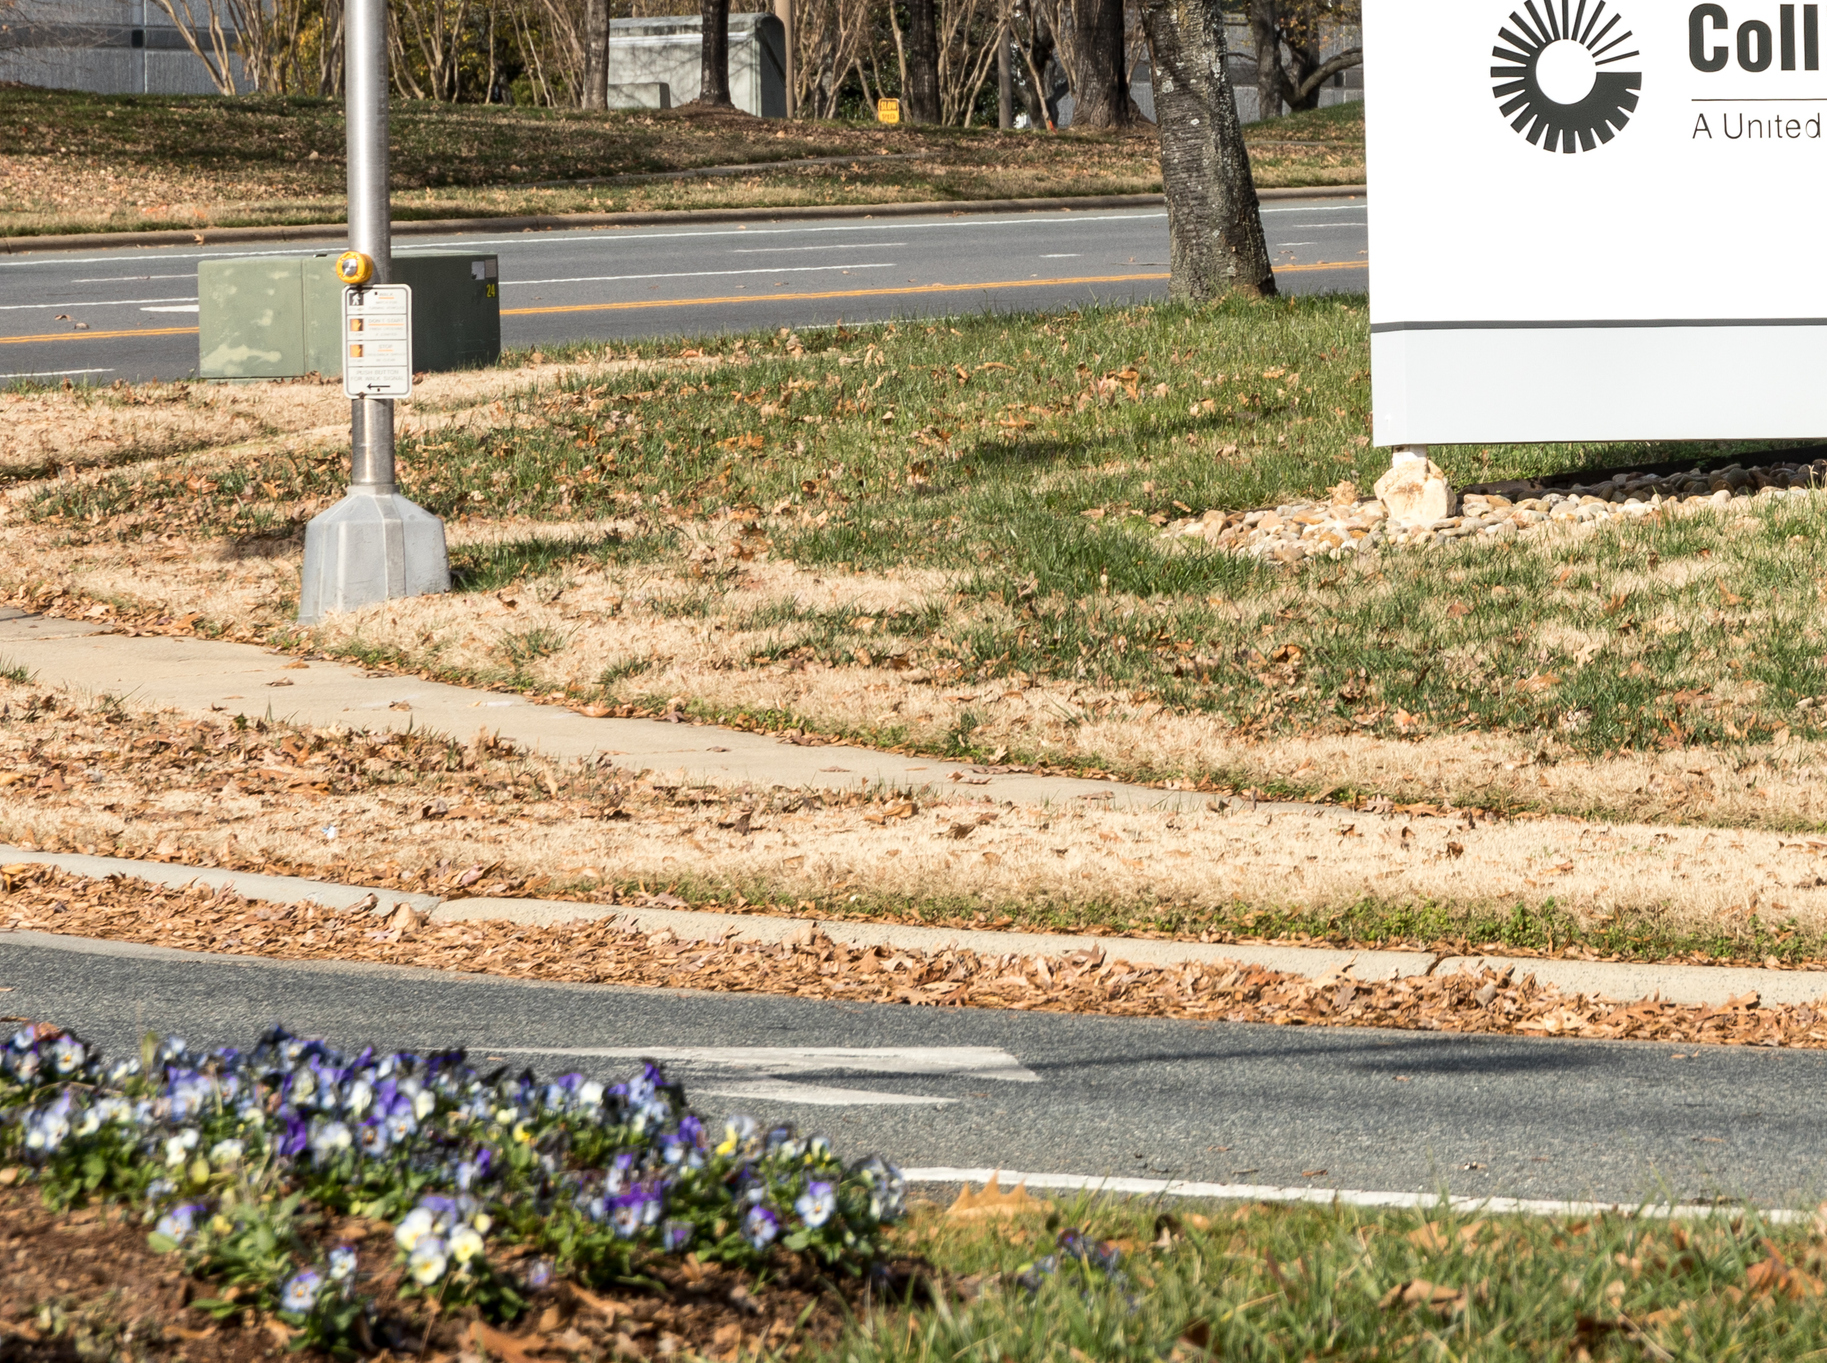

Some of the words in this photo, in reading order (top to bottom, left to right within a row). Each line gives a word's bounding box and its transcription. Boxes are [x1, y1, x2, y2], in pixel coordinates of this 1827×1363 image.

[1691, 112, 1713, 140] A
[1723, 111, 1822, 140] United
[486, 283, 496, 298] 24
